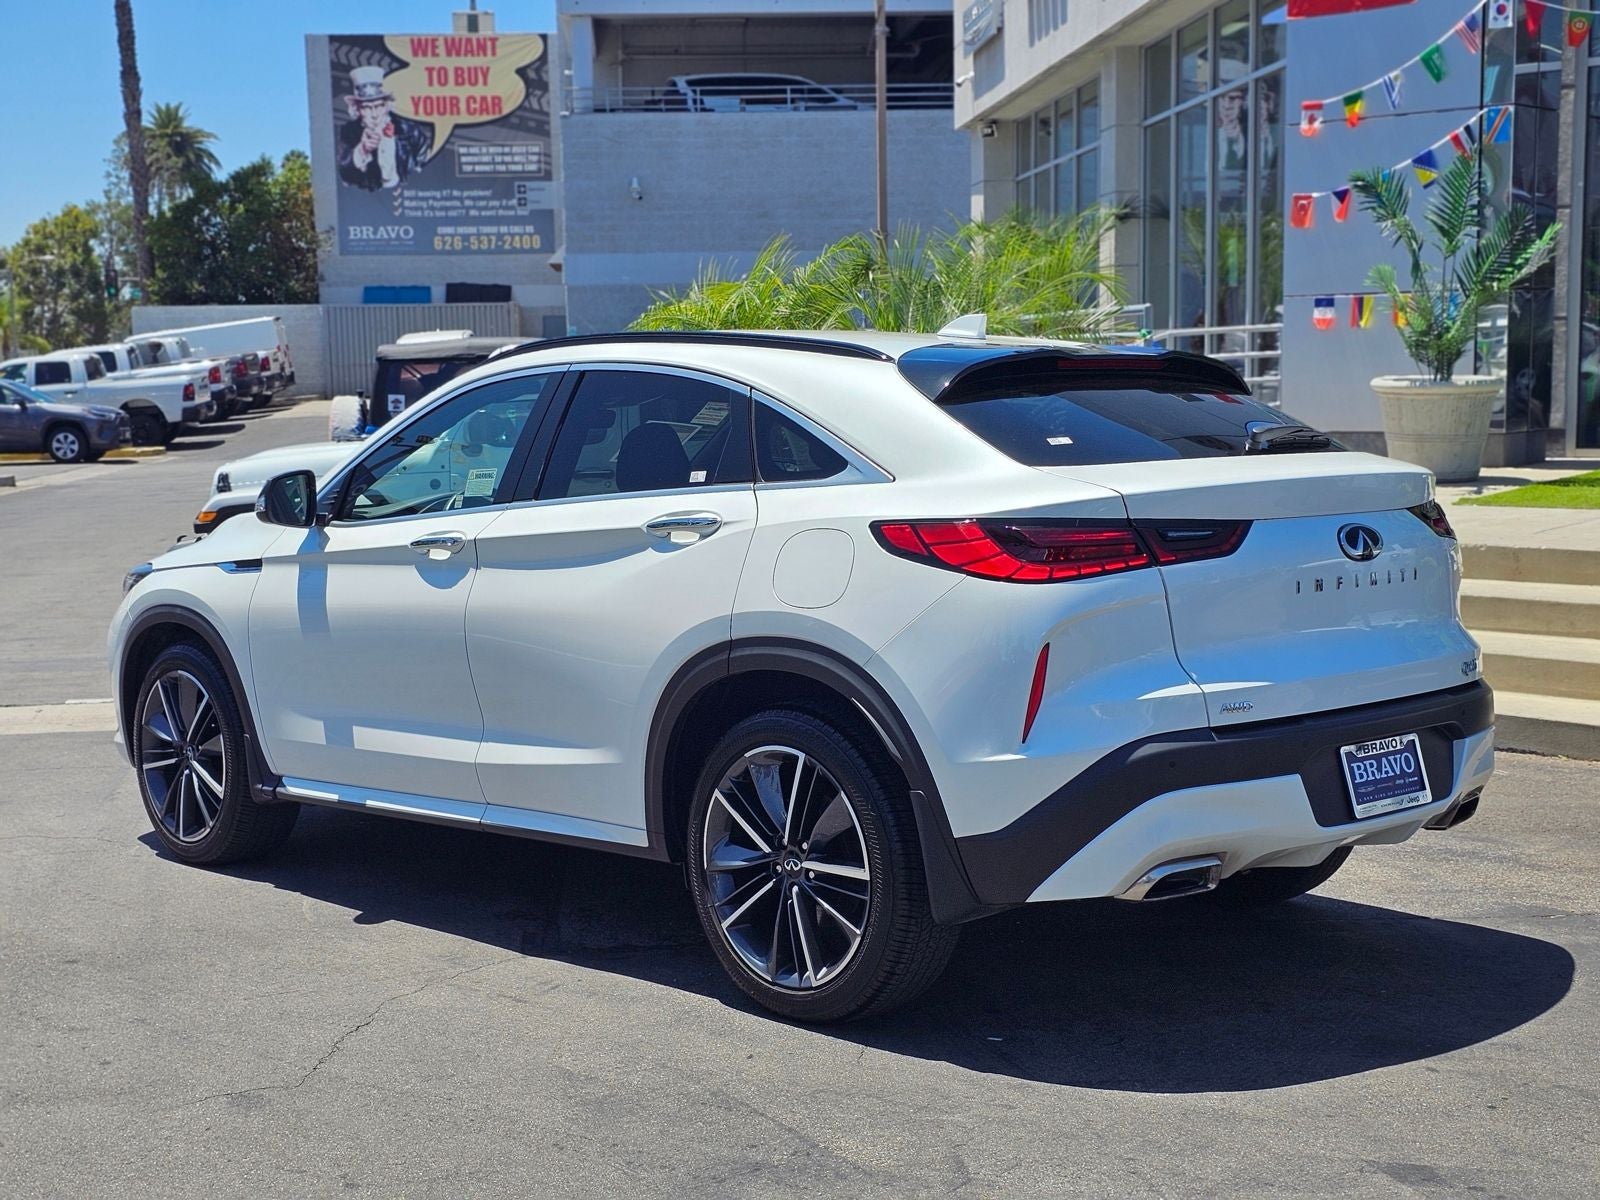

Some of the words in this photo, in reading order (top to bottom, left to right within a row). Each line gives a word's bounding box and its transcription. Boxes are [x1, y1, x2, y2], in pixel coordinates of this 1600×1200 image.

[410, 37, 439, 58] WE
[443, 36, 499, 58] WANT
[424, 66, 449, 87] TO
[454, 66, 490, 87] BUY
[410, 94, 460, 117] YOUR
[465, 94, 503, 117] CAR
[348, 225, 415, 240] BRAVO
[433, 234, 542, 250] 626-537-2400
[1296, 567, 1418, 595] INFINITI
[1219, 701, 1253, 714] AWD
[1363, 738, 1398, 755] BRAVO
[1350, 752, 1415, 783] BRAVO
